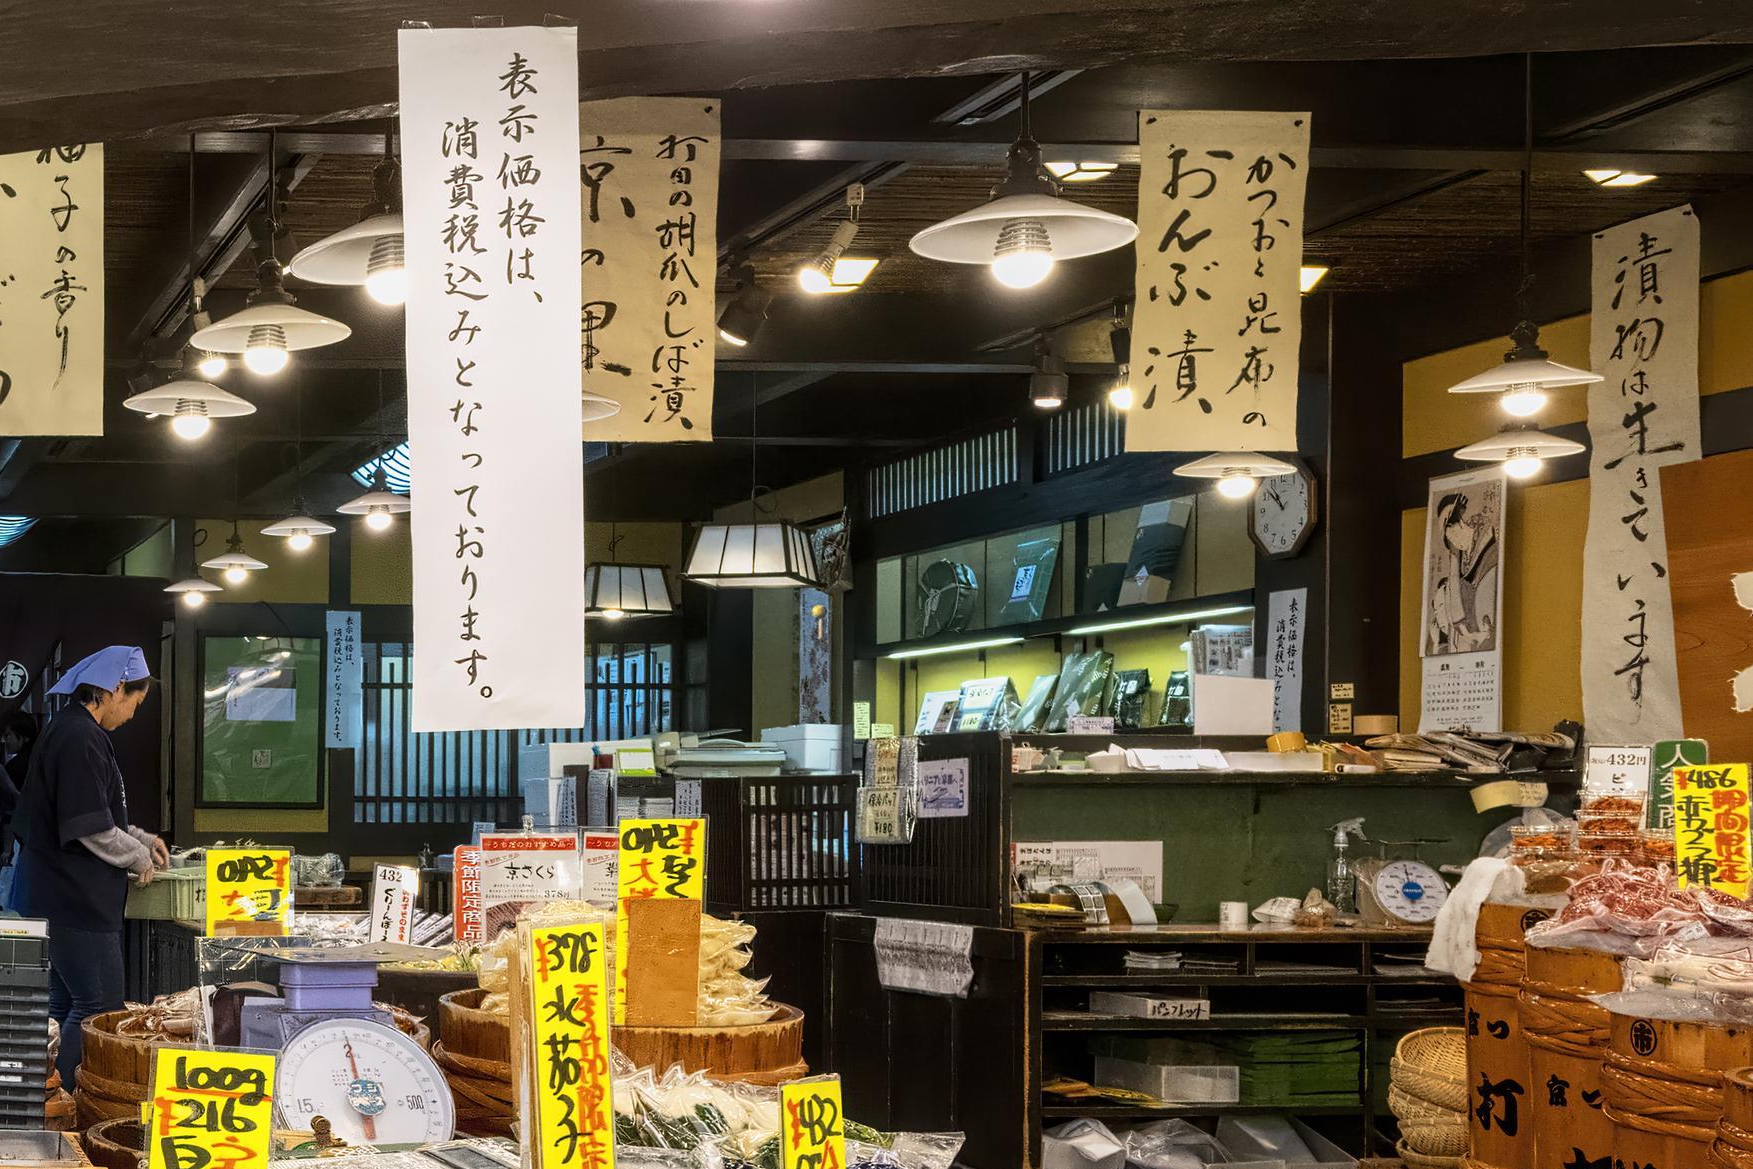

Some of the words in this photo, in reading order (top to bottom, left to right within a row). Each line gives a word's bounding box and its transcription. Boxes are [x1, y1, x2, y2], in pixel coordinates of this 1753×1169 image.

[496, 52, 546, 304] 表示価格は、
[440, 117, 493, 700] 消費税込みとなっております。
[1606, 753, 1647, 766] 432円
[1674, 767, 1738, 790] ¥486
[504, 861, 555, 880] 京さくら
[534, 931, 598, 983] ¥378
[154, 1095, 257, 1136] ¥216
[405, 1095, 424, 1110] 500
